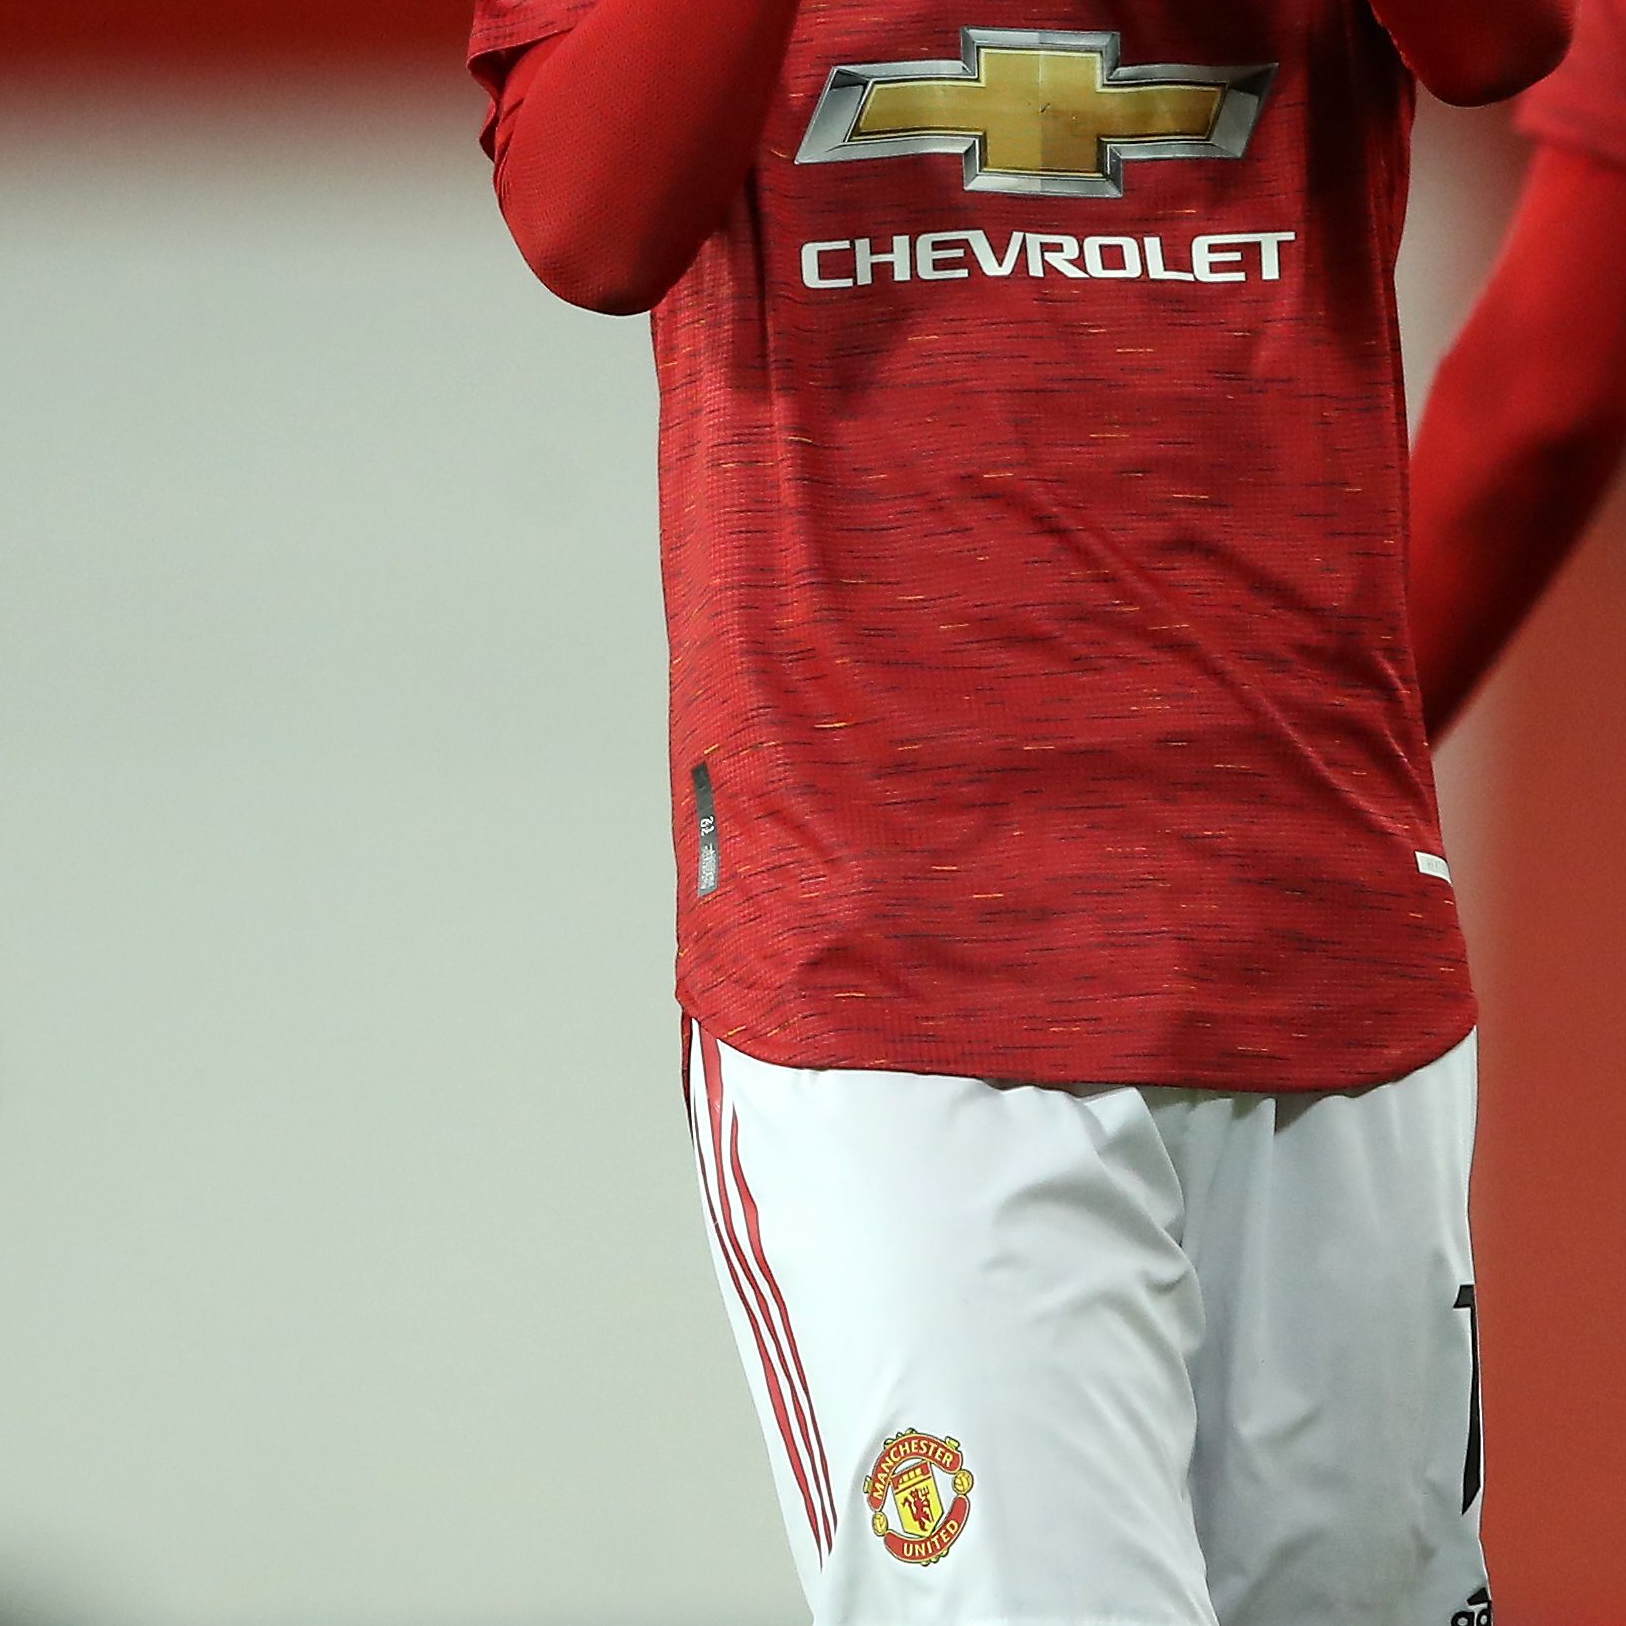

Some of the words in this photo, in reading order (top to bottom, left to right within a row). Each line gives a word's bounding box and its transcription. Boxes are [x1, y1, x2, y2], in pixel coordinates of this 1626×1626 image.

[800, 228, 1296, 289] CHEVROLET
[872, 1439, 954, 1500] MANCHESTER
[903, 1519, 959, 1557] UNITED
